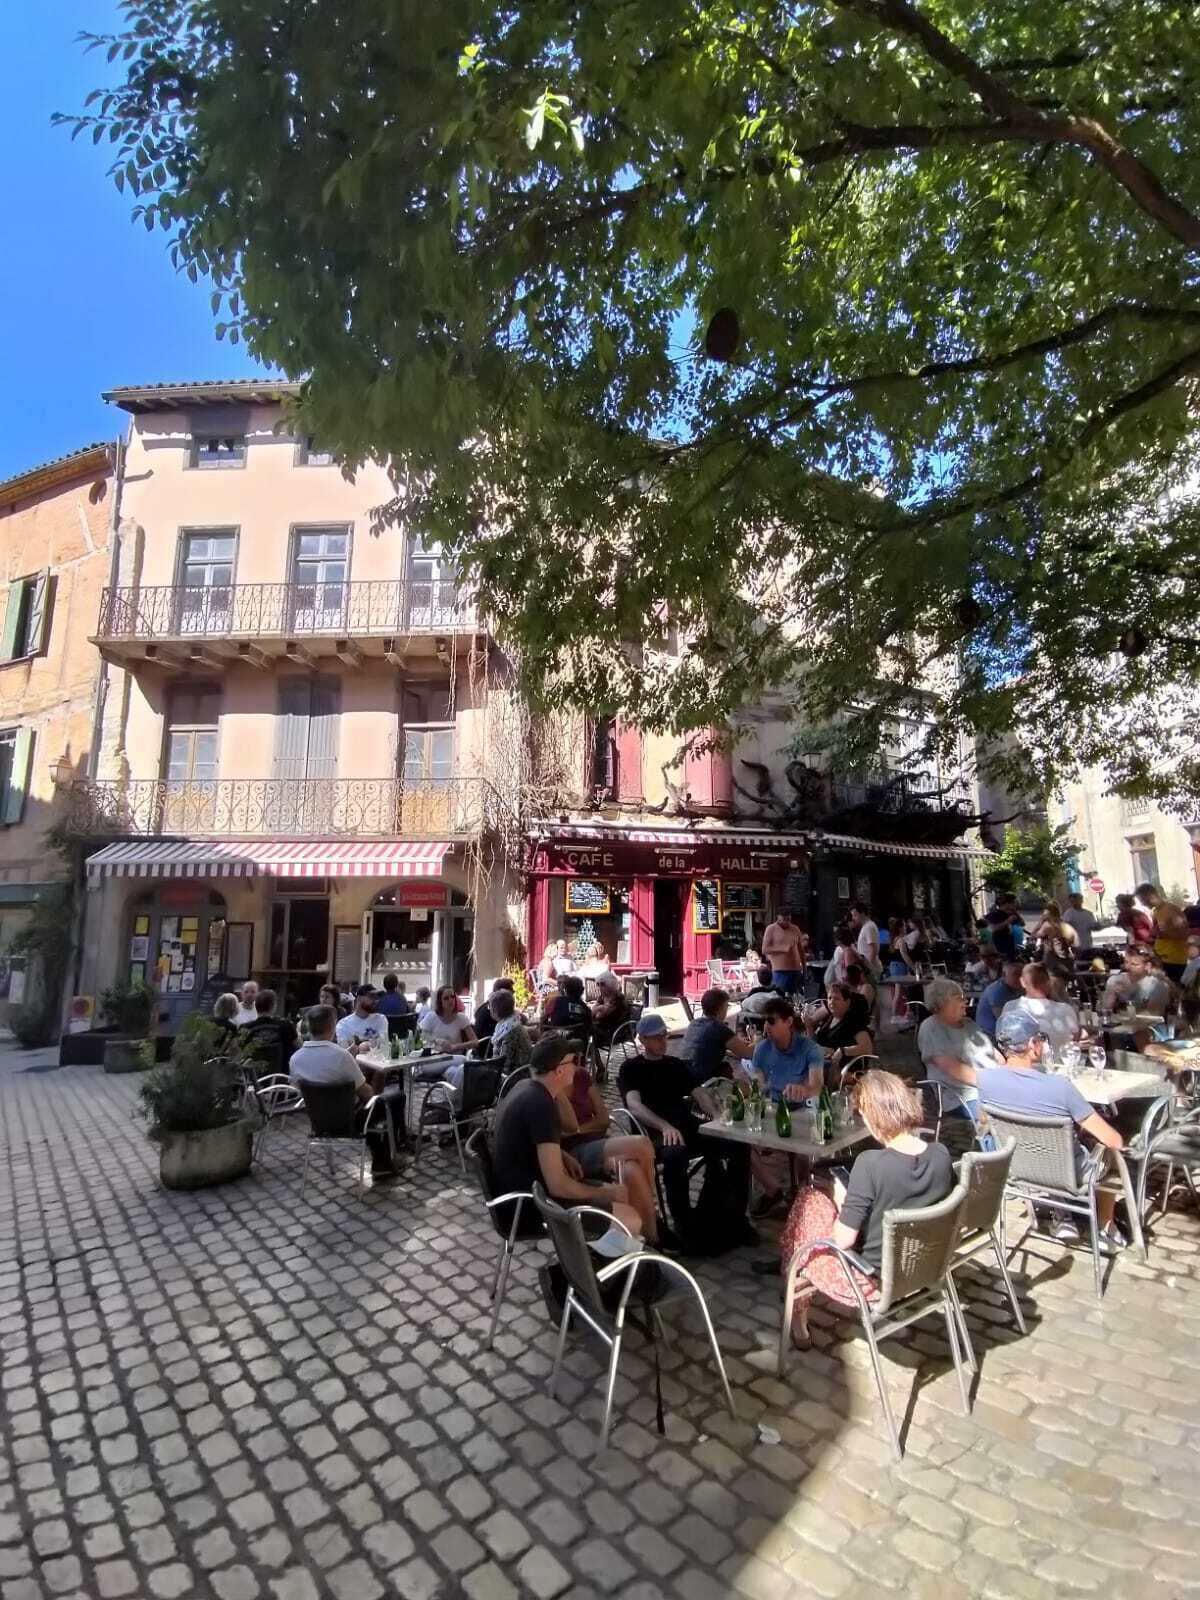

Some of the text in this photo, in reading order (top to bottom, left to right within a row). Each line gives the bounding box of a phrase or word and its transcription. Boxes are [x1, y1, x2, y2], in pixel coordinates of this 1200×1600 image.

[568, 852, 769, 871] CAFÉ de la HALLE
